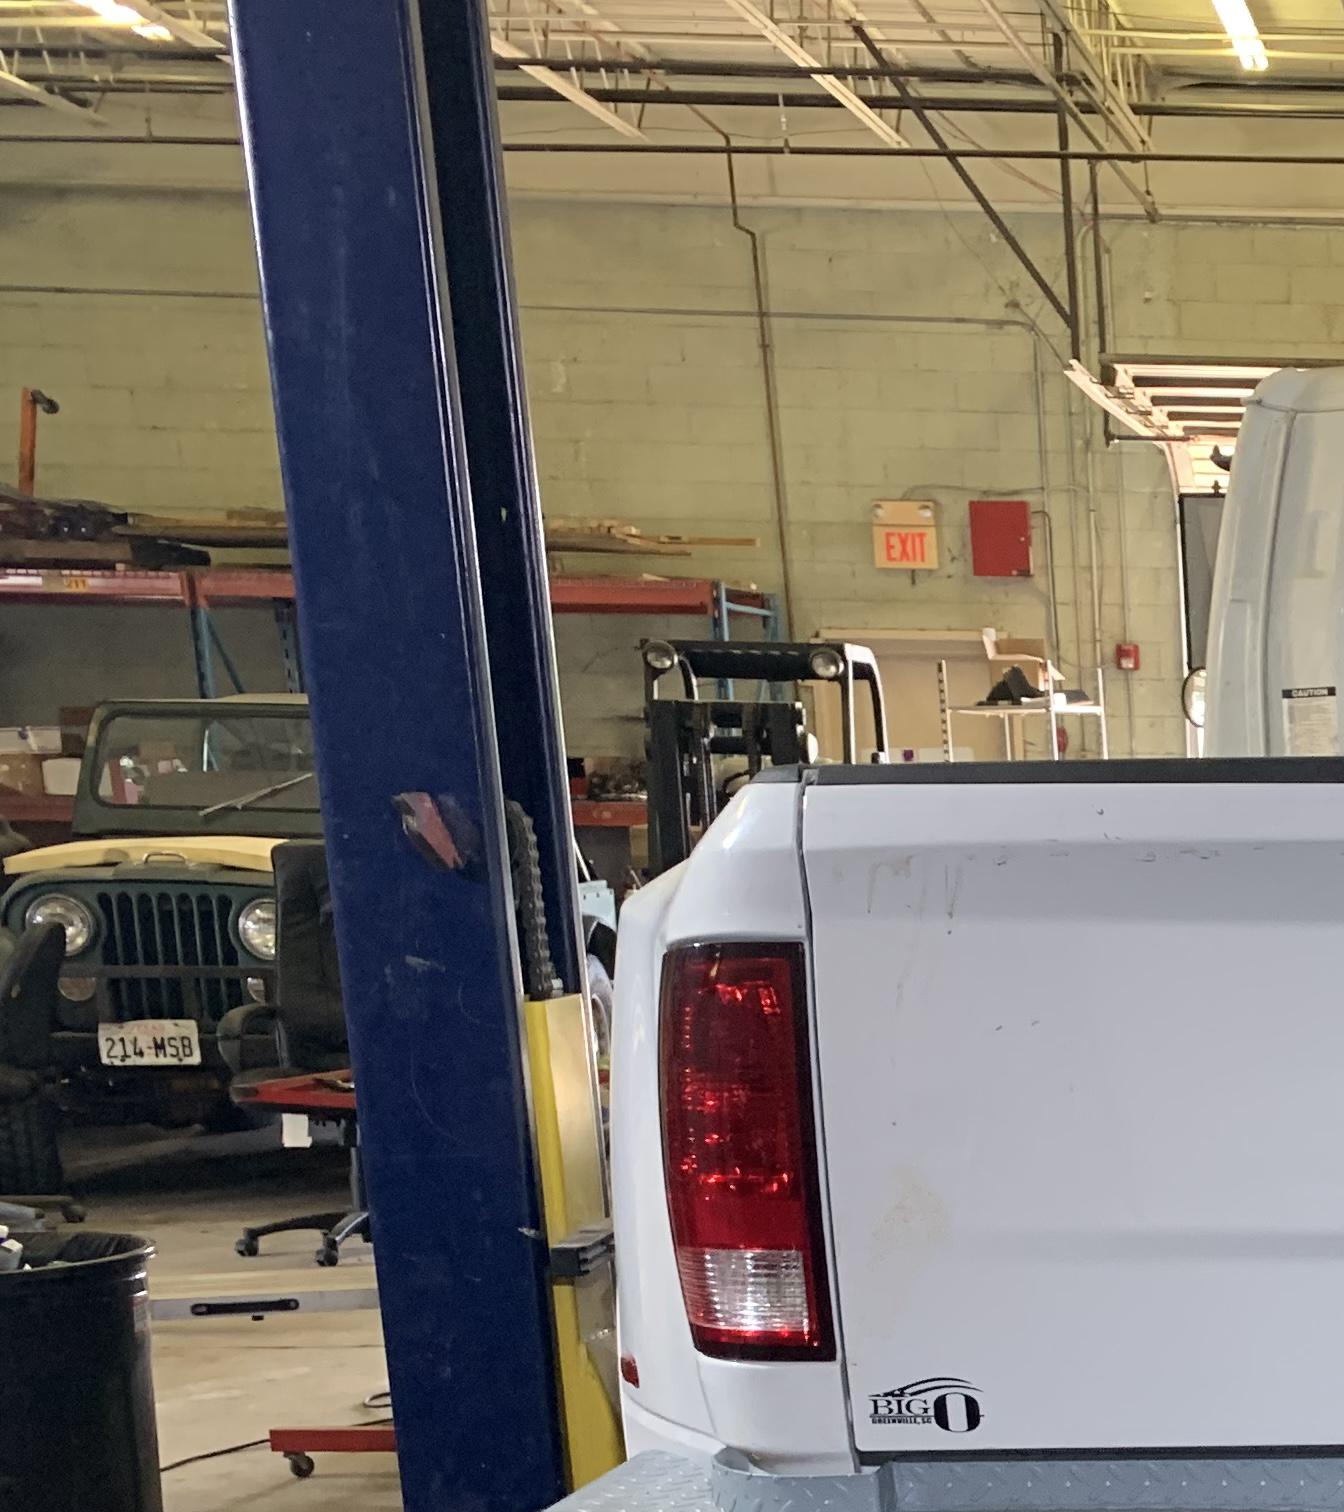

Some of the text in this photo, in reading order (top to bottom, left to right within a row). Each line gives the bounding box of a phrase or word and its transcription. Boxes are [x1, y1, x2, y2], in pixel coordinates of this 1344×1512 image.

[884, 531, 928, 562] EXIT
[1292, 688, 1328, 697] CAUTION
[104, 1036, 194, 1059] 214-MSB
[870, 1392, 981, 1432] BIG O
